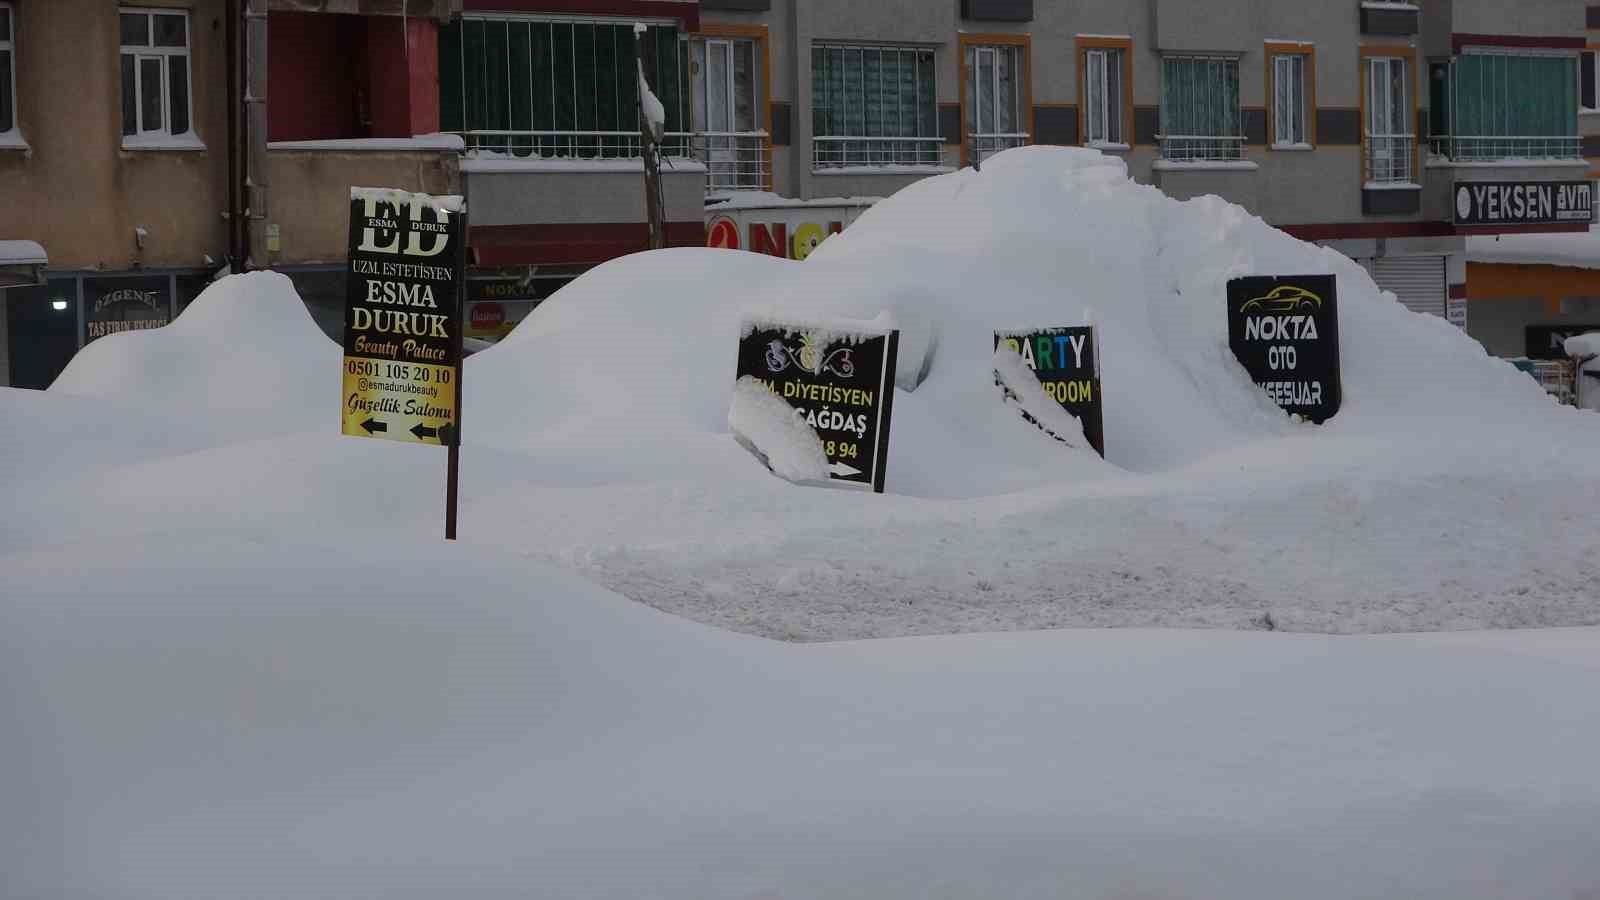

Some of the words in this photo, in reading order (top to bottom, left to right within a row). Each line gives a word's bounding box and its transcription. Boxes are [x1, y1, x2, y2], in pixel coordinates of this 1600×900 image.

[1473, 185, 1552, 219] YEKSEN
[368, 218, 398, 228] ESMA
[412, 222, 447, 233] DURUK
[353, 259, 380, 275] UZM.
[383, 261, 453, 281] ESTETİSYEN
[366, 279, 438, 308] ESMA
[351, 306, 449, 338] DURUK
[1245, 314, 1318, 341] NOKTA
[354, 335, 400, 360] Beauty
[402, 339, 446, 361] Palace
[1268, 346, 1297, 370] OTO
[348, 360, 379, 377] 0501
[386, 364, 409, 381] 105
[413, 367, 430, 382] 20
[436, 369, 450, 384] 10
[368, 382, 438, 398] esmadurukbeauty
[783, 378, 873, 407] DİYETİSYEN
[347, 392, 401, 416] Güzellik
[403, 399, 452, 420] Salonu
[839, 441, 858, 460] 94
